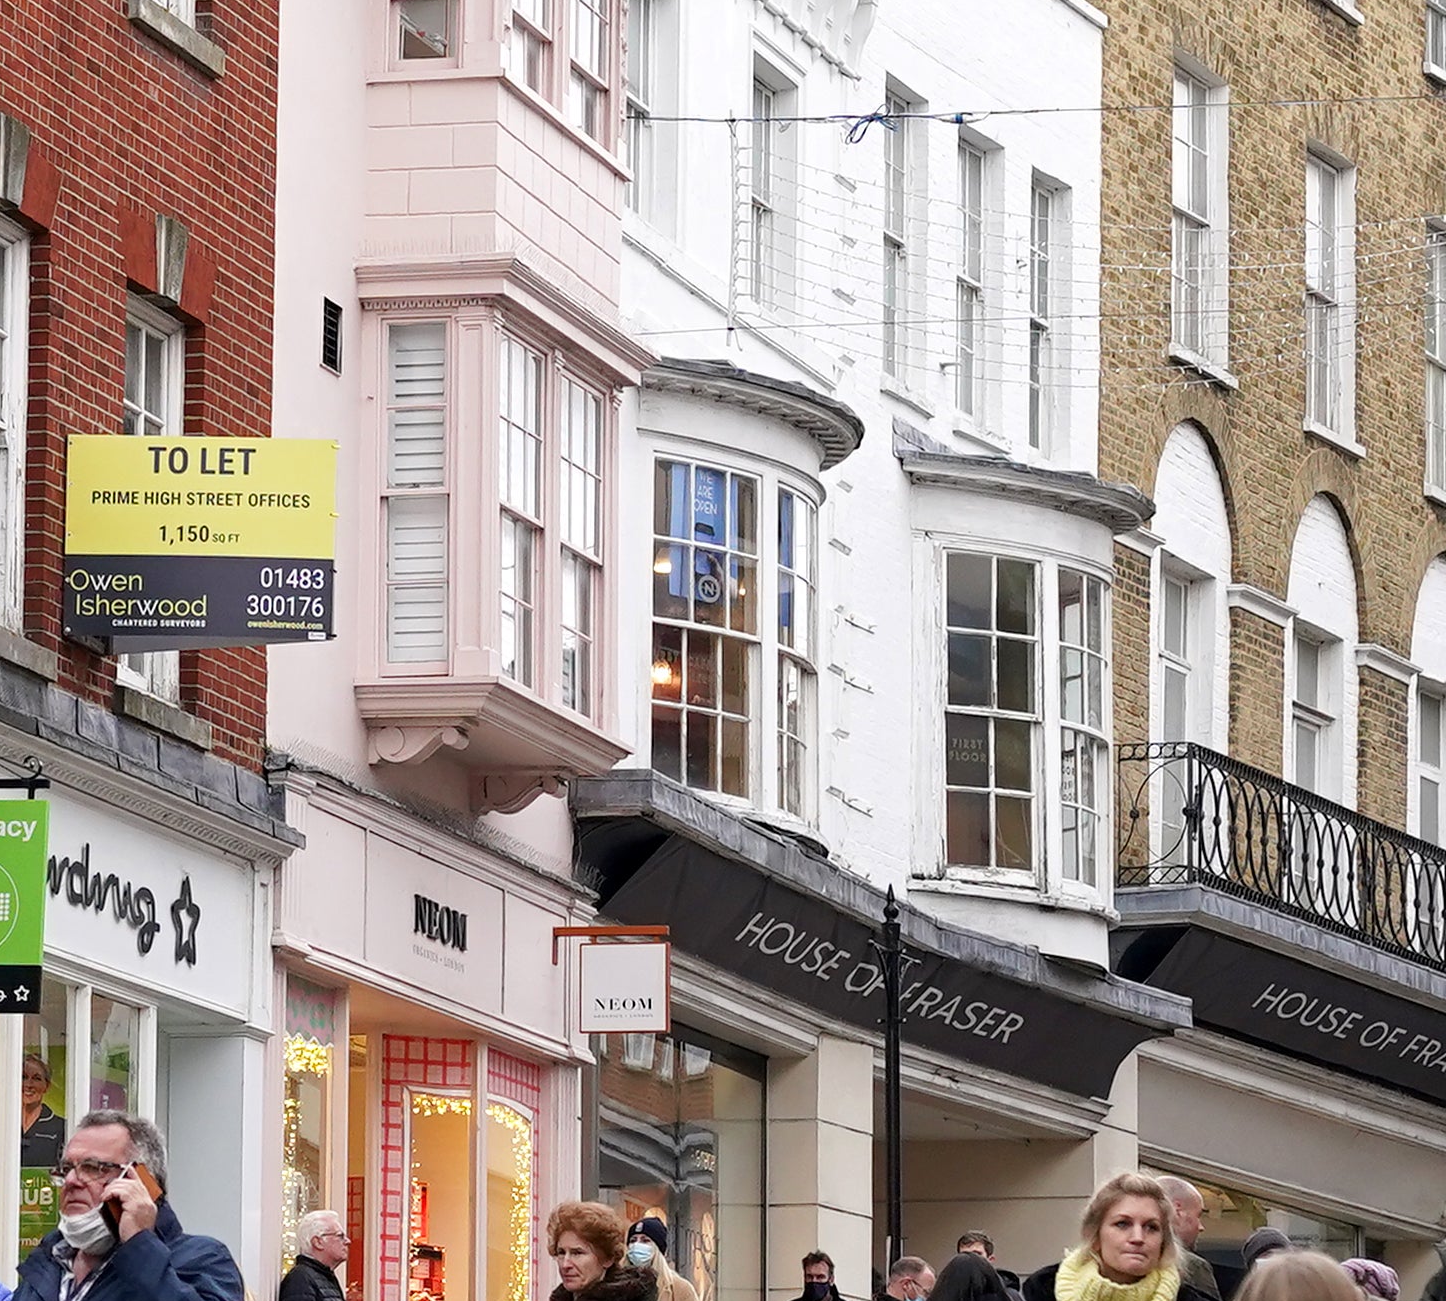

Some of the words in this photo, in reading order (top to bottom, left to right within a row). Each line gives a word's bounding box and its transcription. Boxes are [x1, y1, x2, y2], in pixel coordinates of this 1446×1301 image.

[148, 446, 188, 474] TO
[200, 447, 257, 476] LET
[91, 490, 139, 506] PRIME
[144, 492, 181, 506] HIGH
[186, 492, 243, 507] STREET
[248, 493, 311, 509] OFFICES
[697, 487, 714, 500] ARE
[159, 525, 210, 546] 1,150
[212, 533, 225, 544] SQ
[228, 533, 241, 543] FT
[69, 568, 143, 592] Owen
[260, 567, 325, 590] 01483
[76, 594, 207, 617] Isherwood
[247, 594, 324, 618] 300176
[112, 619, 158, 628] CHARTERED
[160, 619, 206, 628] SURVEYORS
[414, 894, 468, 953] NEOM
[734, 912, 850, 982] HOUSE
[594, 998, 653, 1010] NEOM
[1251, 983, 1363, 1039] HOUSE
[1359, 1021, 1407, 1051] OF
